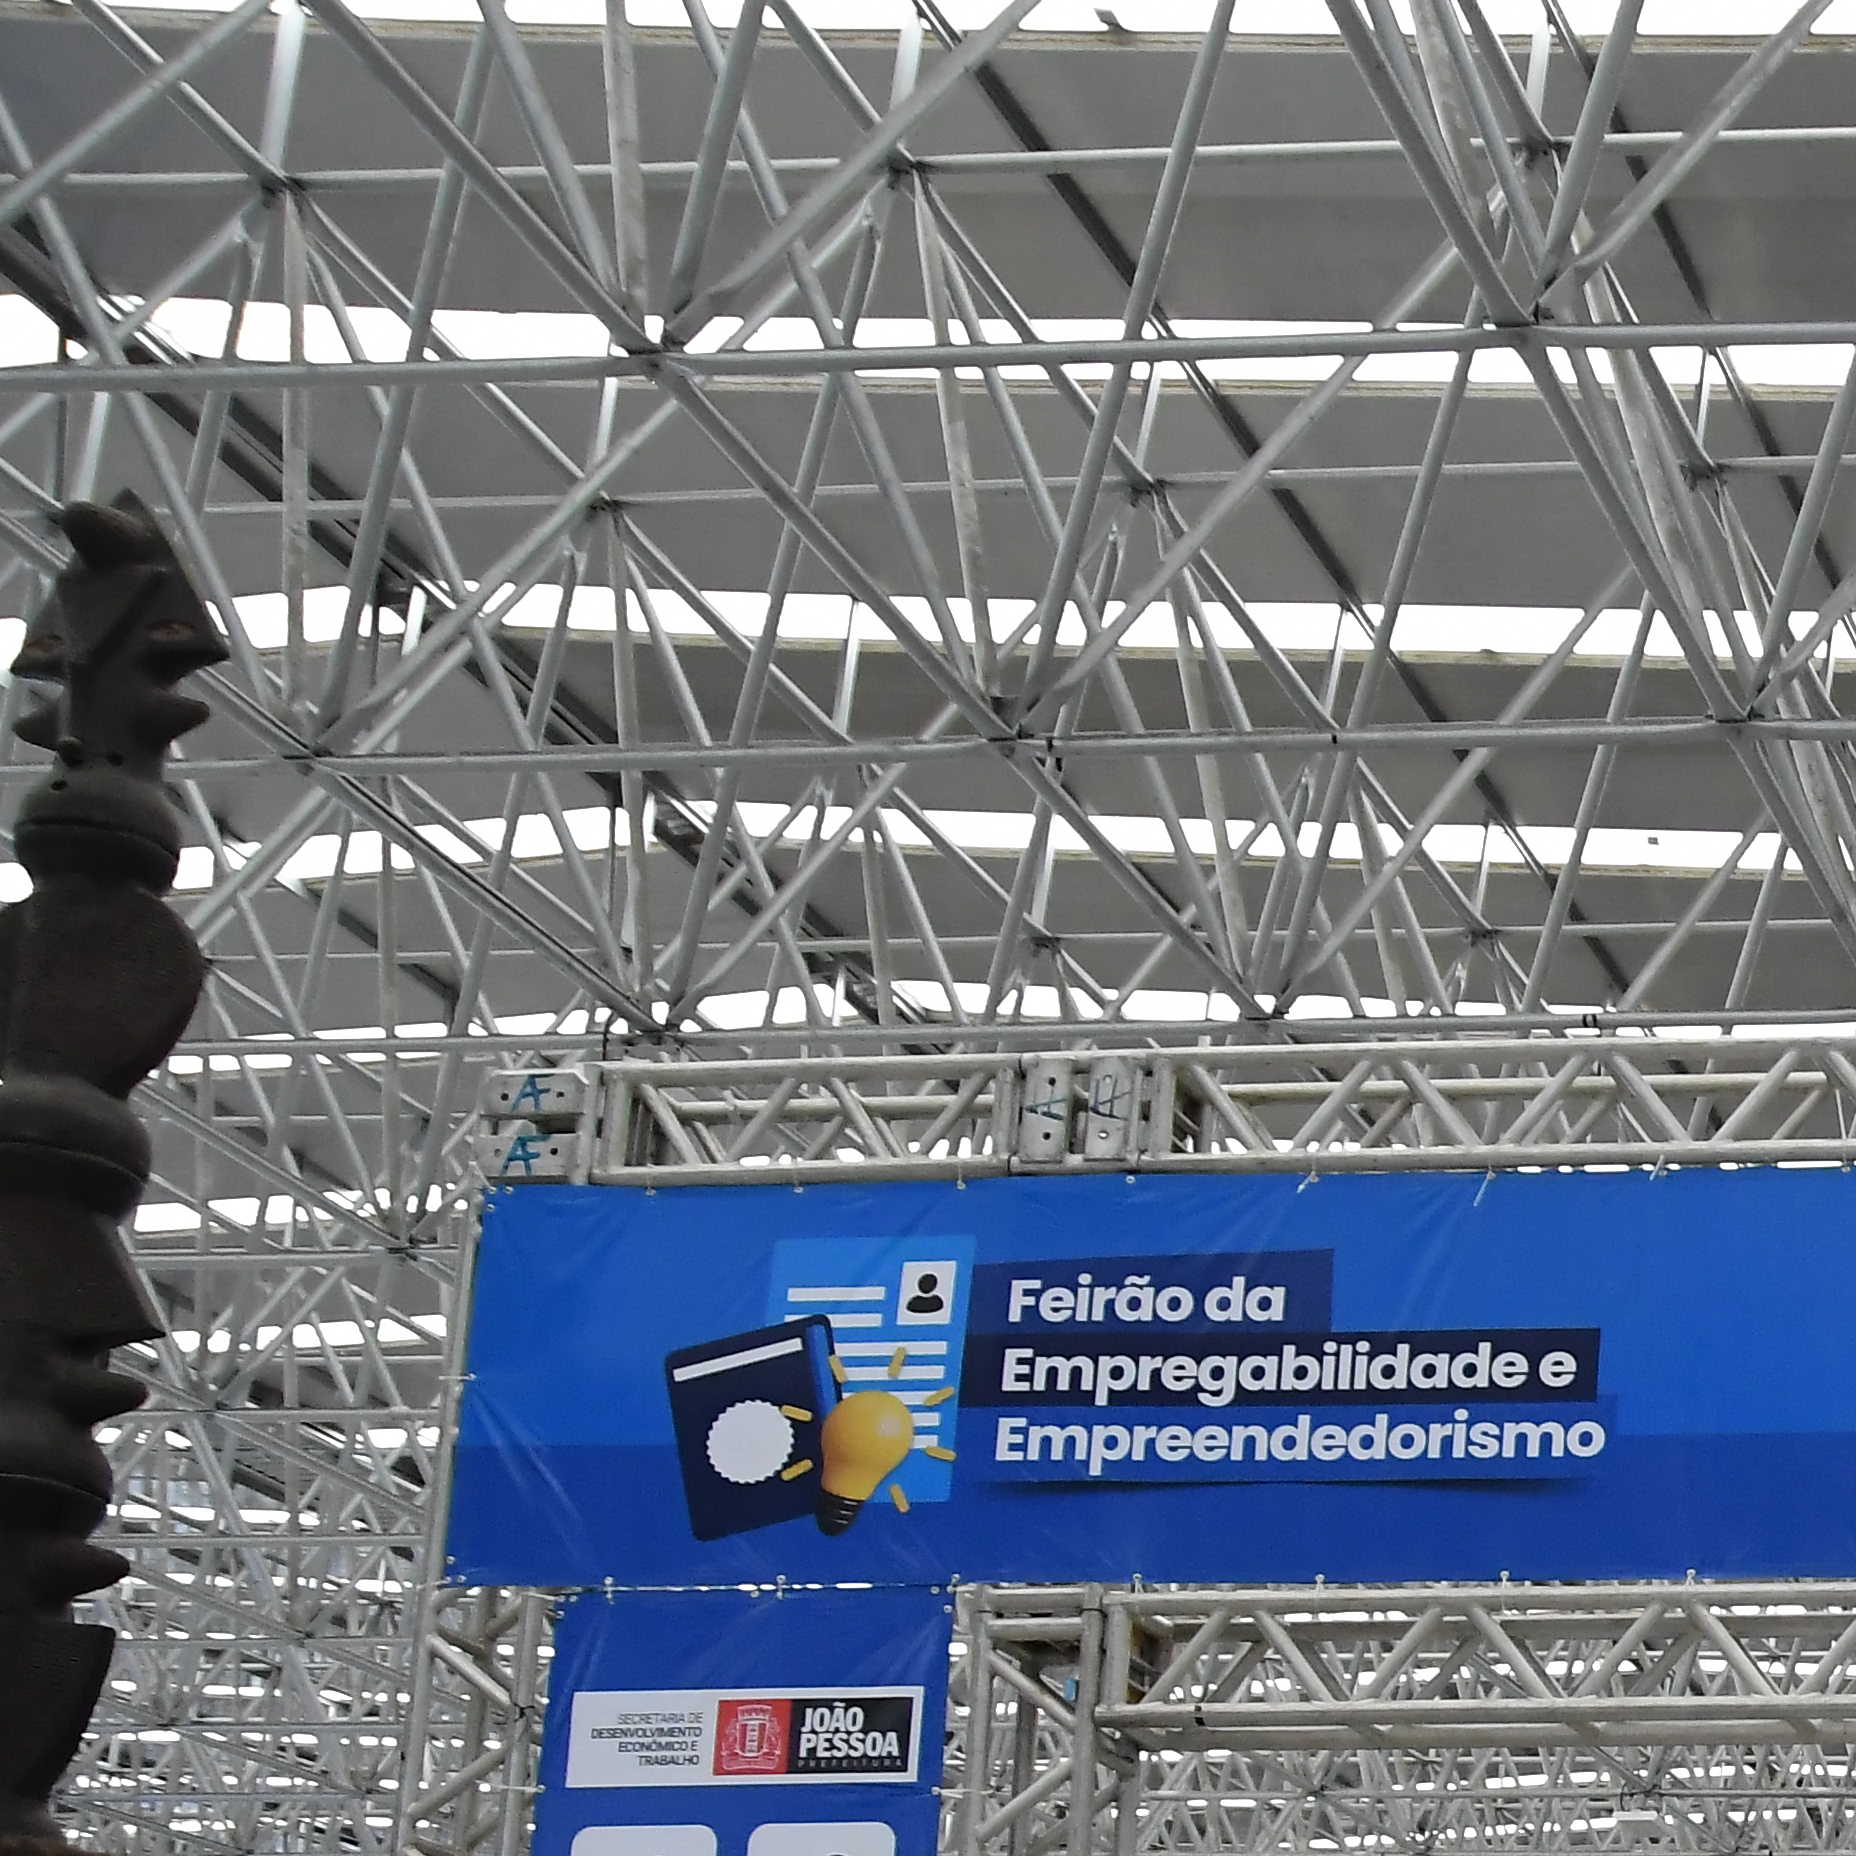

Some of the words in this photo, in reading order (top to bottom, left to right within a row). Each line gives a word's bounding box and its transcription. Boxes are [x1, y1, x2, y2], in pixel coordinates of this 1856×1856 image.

[1007, 1273, 1195, 1325] Feirão
[1204, 1277, 1286, 1324] da
[1001, 1341, 1530, 1406] Empregabilidade
[1538, 1350, 1576, 1387] e
[994, 1410, 1606, 1475] Empreendedorismo
[617, 1712, 687, 1726] SECRETARIA
[689, 1711, 704, 1724] DE
[801, 1702, 865, 1734] JOÃO
[590, 1726, 703, 1740] DESENVOLVIMENTO
[690, 1740, 698, 1752] E
[799, 1731, 900, 1758] PESSOA
[637, 1754, 700, 1767] TRABALHO
